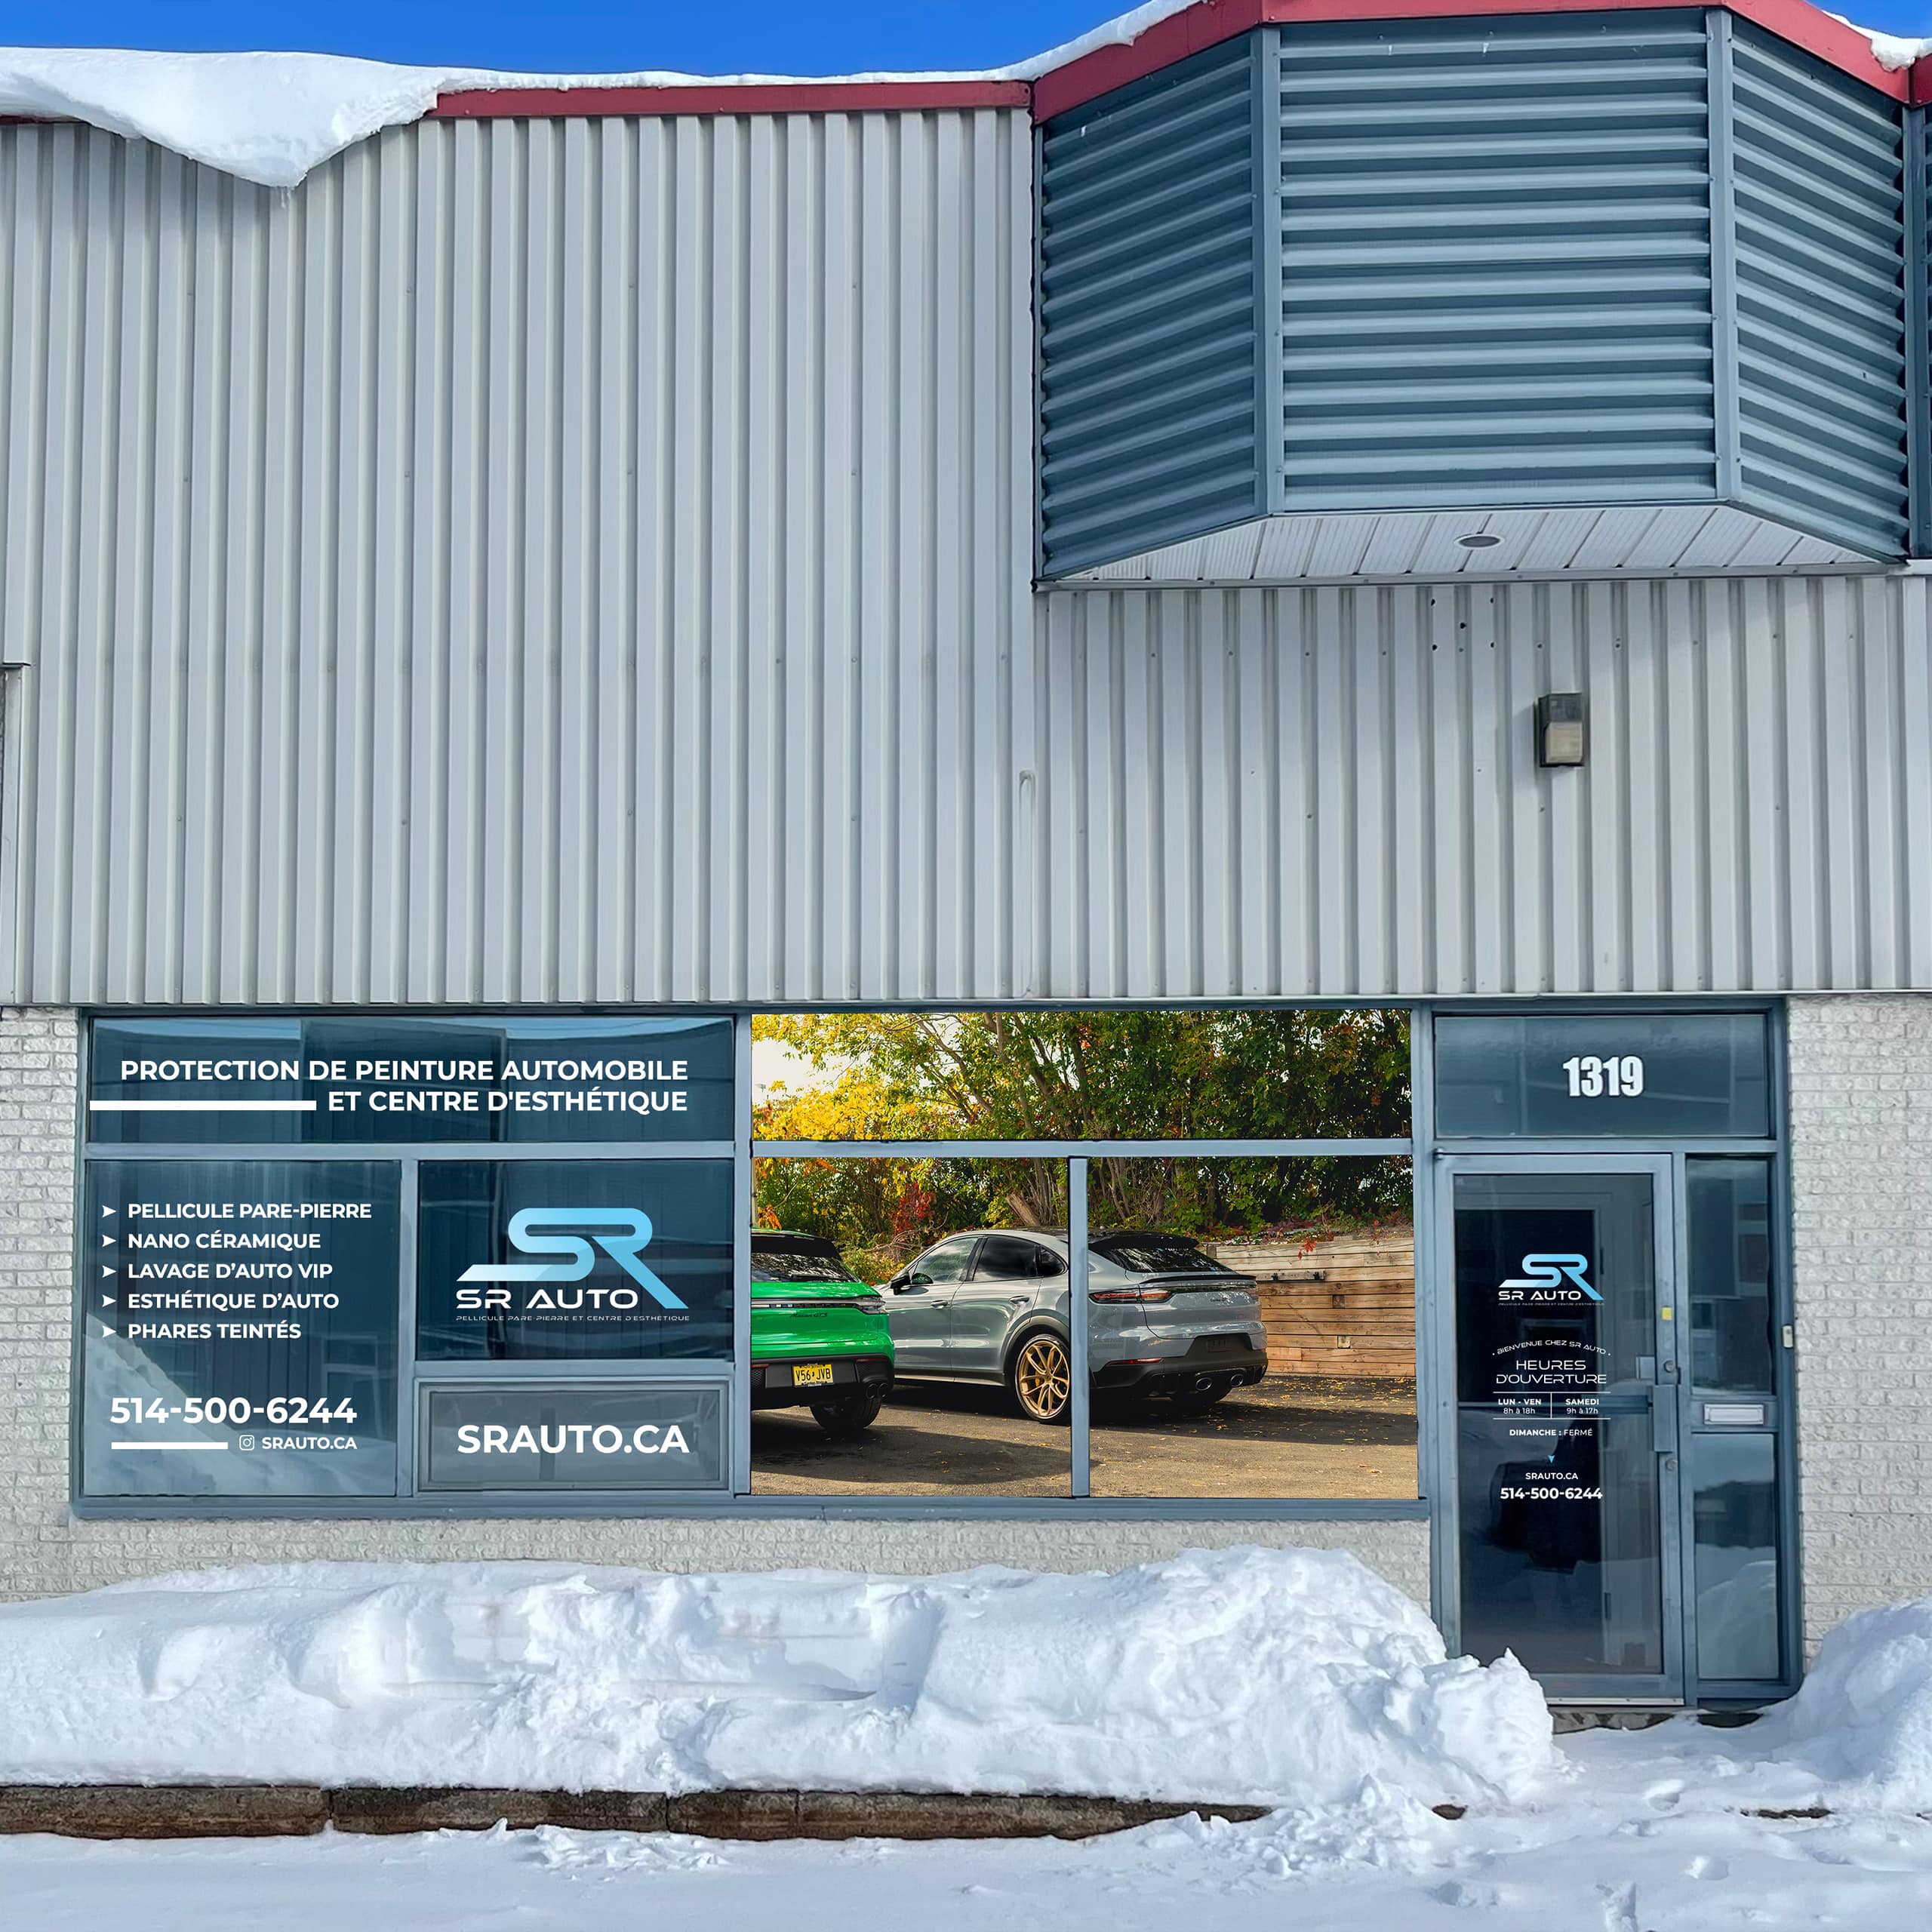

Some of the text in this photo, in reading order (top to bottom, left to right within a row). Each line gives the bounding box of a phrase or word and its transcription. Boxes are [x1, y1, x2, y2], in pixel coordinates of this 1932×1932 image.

[122, 1060, 688, 1081] PROTECTION DE PEINTURE AUTOMOBILE
[1562, 1055, 1644, 1097] 1319
[329, 1086, 688, 1115] ET CENTRE D'ESTHÉTIQUE
[128, 1203, 372, 1219] PELLICULE PARE-PIERRE
[128, 1229, 321, 1251] NANO CÉRAMIQUE
[128, 1263, 333, 1278] LAVAGE D’AUTO VIP
[128, 1290, 339, 1312] ESTHÉTIQUE D’AUTO
[456, 1289, 638, 1309] SR AUTO
[1498, 1291, 1582, 1300] SR AUTO
[128, 1320, 301, 1339] PHARES TEINTÉS
[1497, 1340, 1543, 1355] BIENVENUE
[1583, 1344, 1607, 1355] AUTO
[1515, 1360, 1587, 1371] HEURES
[1496, 1374, 1607, 1384] D'OUVERTURE
[109, 1396, 357, 1424] 514-500-6244
[457, 1423, 690, 1454] SRAUTO.CA
[1563, 1428, 1593, 1436] FERMÉ
[262, 1437, 358, 1450] SRAUTO.CA
[1500, 1487, 1603, 1500] 514-500-6244
